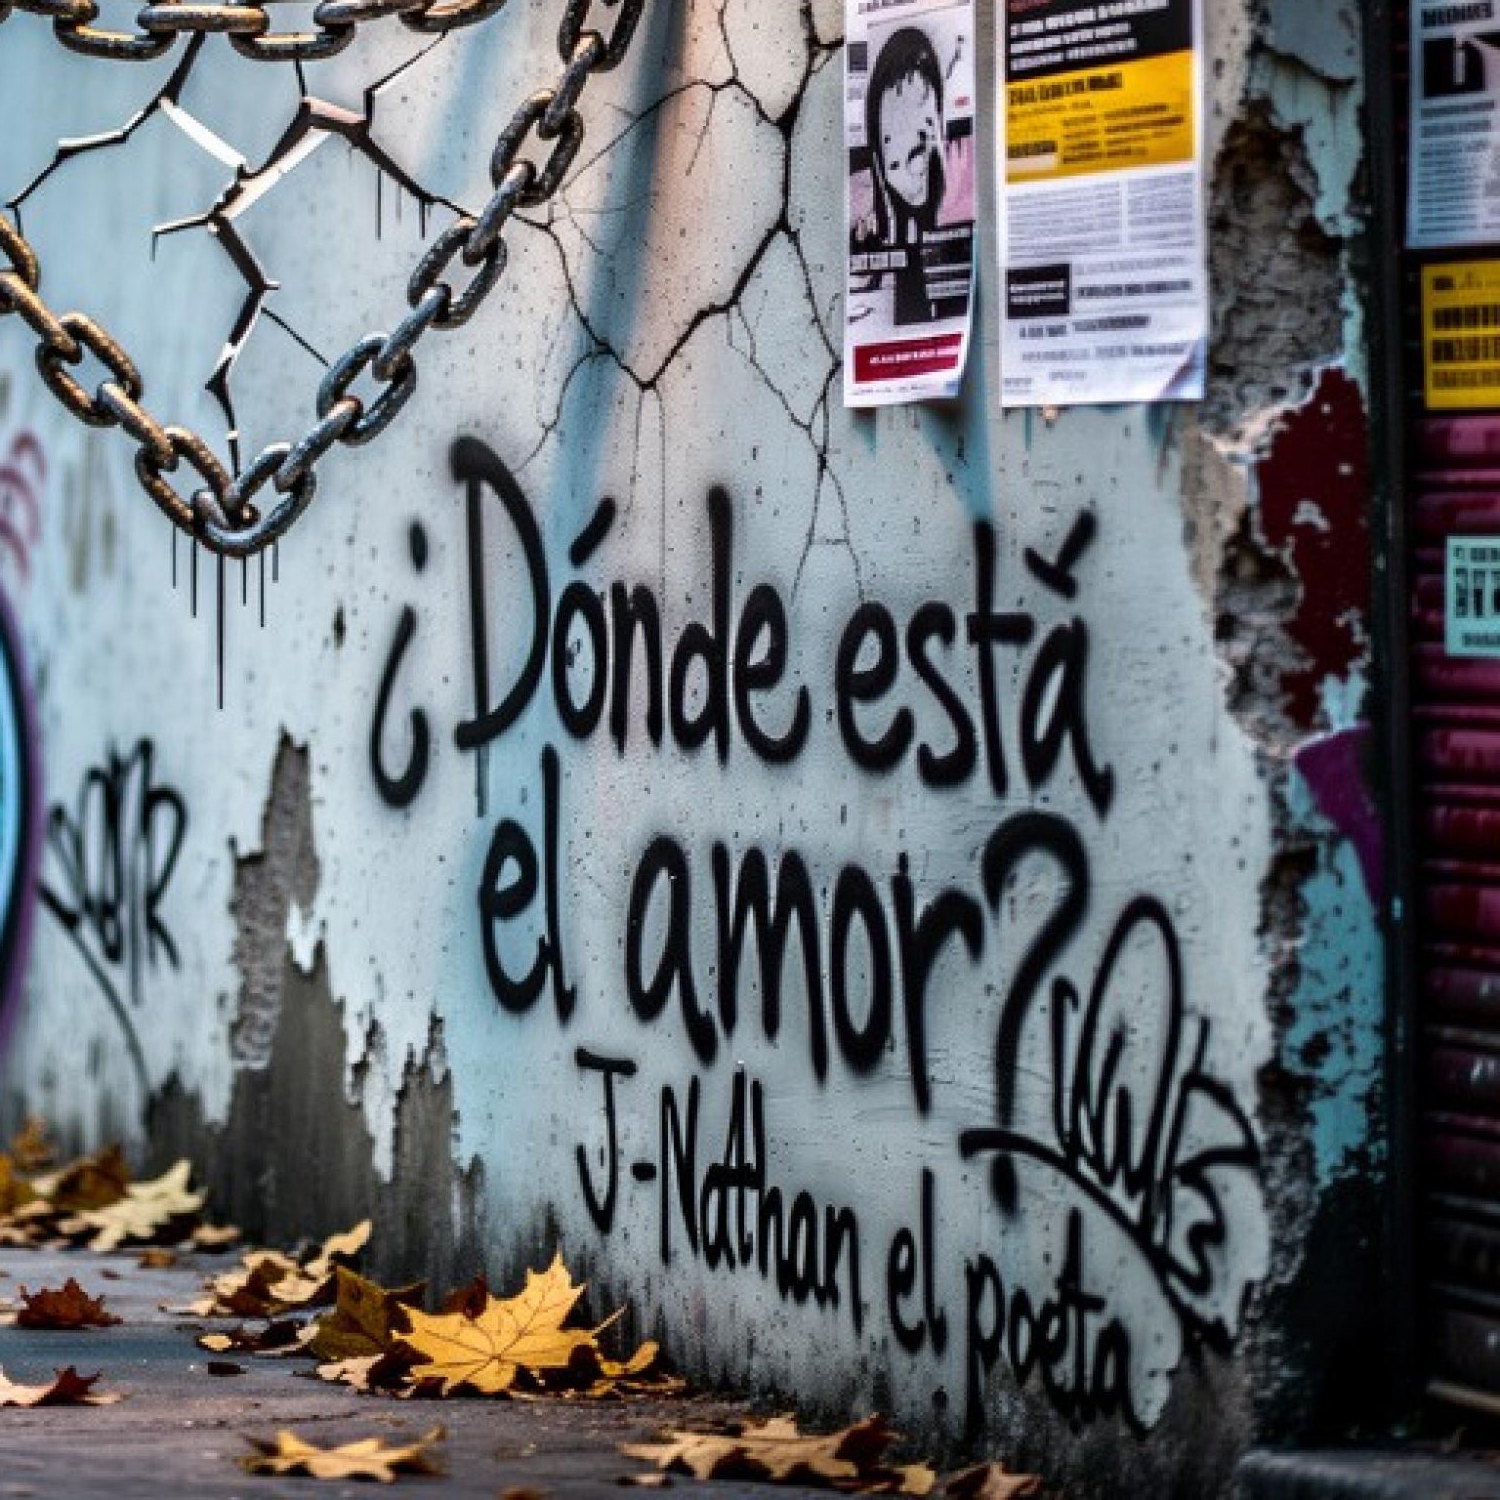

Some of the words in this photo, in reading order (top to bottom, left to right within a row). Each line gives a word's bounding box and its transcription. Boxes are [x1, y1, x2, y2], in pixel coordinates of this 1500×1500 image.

[369, 435, 811, 812] ¿Dónde
[836, 506, 1115, 820] está
[479, 745, 578, 1025] el
[625, 810, 1090, 1214] amor?
[574, 1048, 865, 1338] J-Nathan
[888, 1167, 949, 1362] el
[965, 1206, 1152, 1445] poeta
